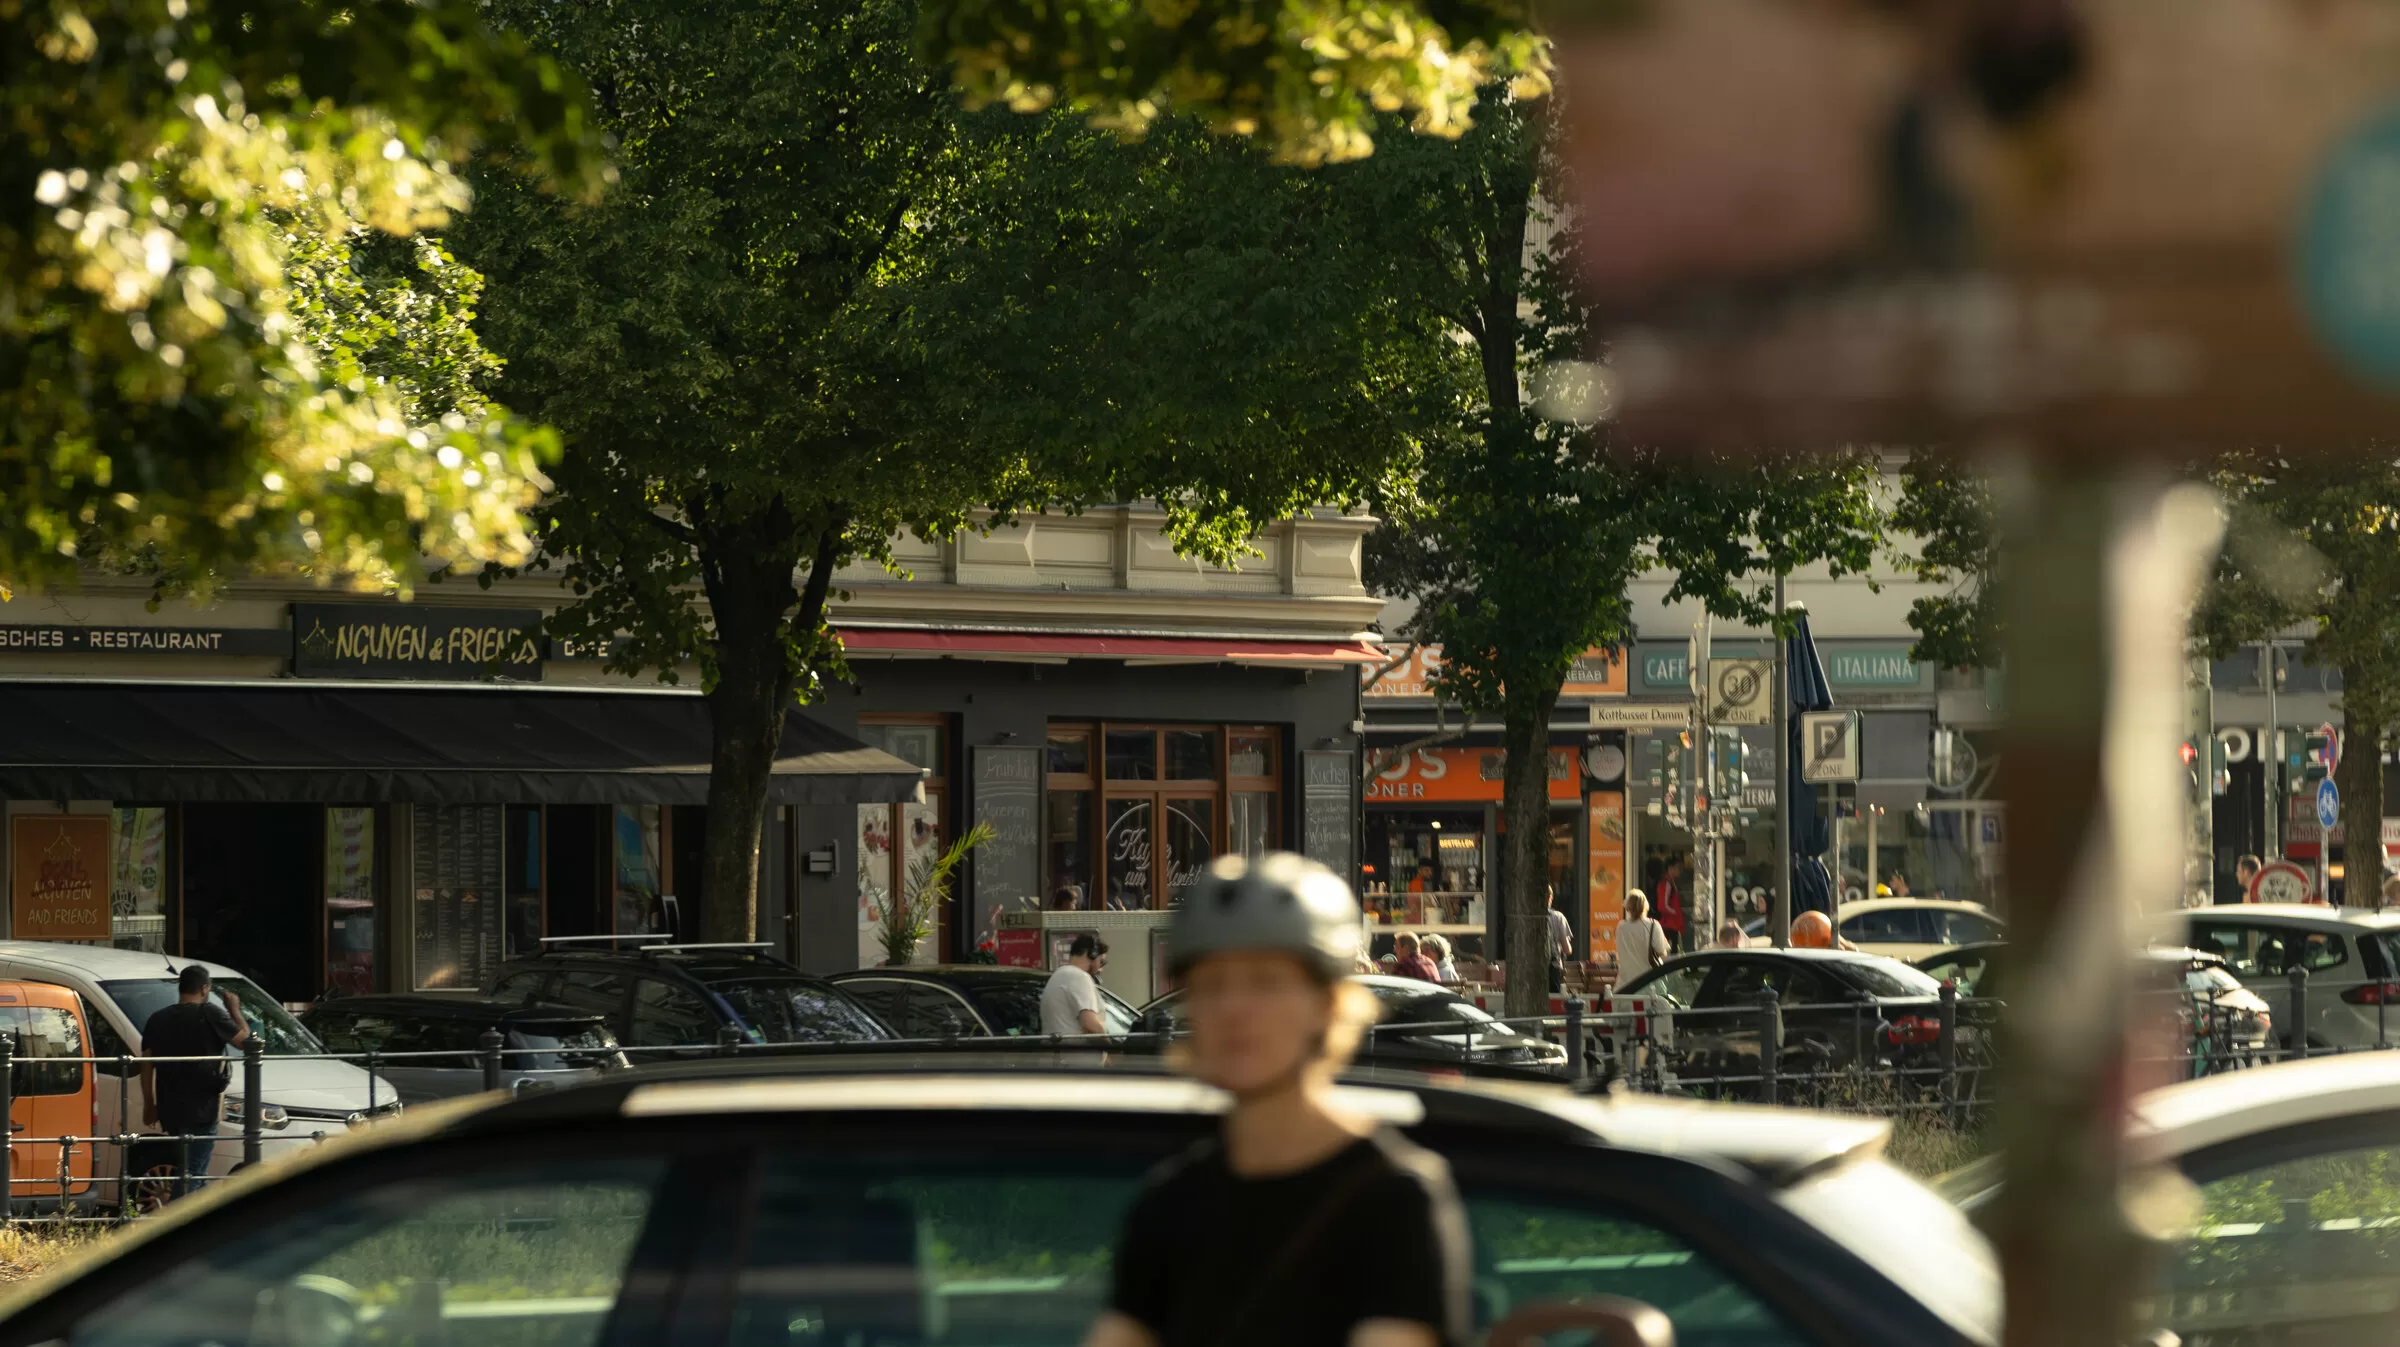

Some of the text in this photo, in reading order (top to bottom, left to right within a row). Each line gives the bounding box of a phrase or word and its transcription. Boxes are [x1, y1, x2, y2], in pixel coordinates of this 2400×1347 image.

[90, 631, 222, 650] RESTAURANT
[336, 624, 427, 664] NGUYEN
[430, 636, 445, 662] &
[1836, 655, 1914, 681] ITALIANA
[1597, 707, 1684, 722] Kottbusser Damm
[27, 905, 99, 925] AND FRIENDS
